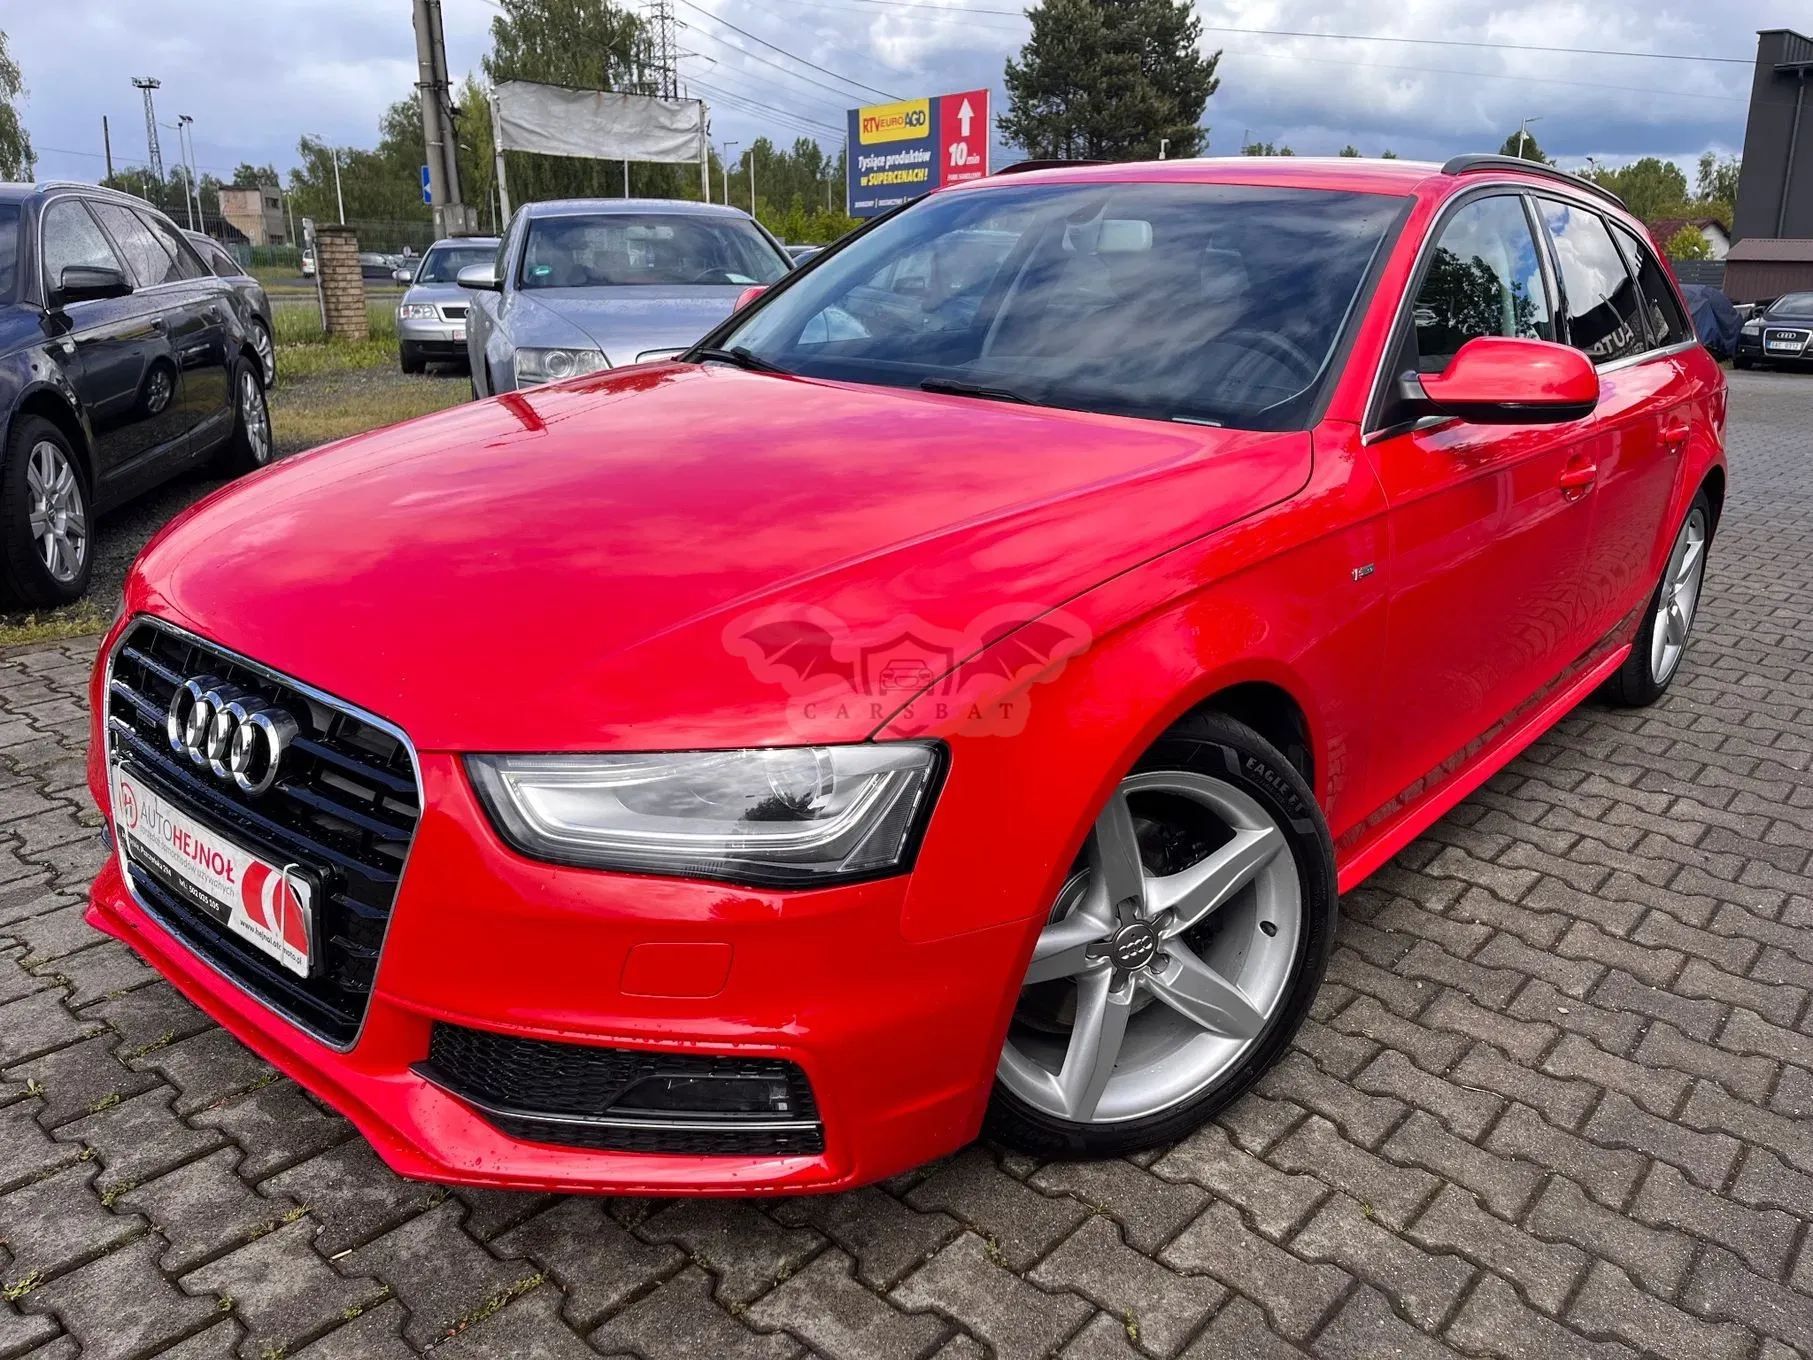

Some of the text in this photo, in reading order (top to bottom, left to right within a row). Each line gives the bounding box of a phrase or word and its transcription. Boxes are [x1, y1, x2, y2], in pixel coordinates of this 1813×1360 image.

[863, 110, 926, 134] RTV EURO AGD
[858, 148, 931, 172] Tysiące produktów
[949, 142, 968, 166] 10
[861, 168, 928, 186] w SUPERCENACH!
[1246, 757, 1290, 794] EAGLE
